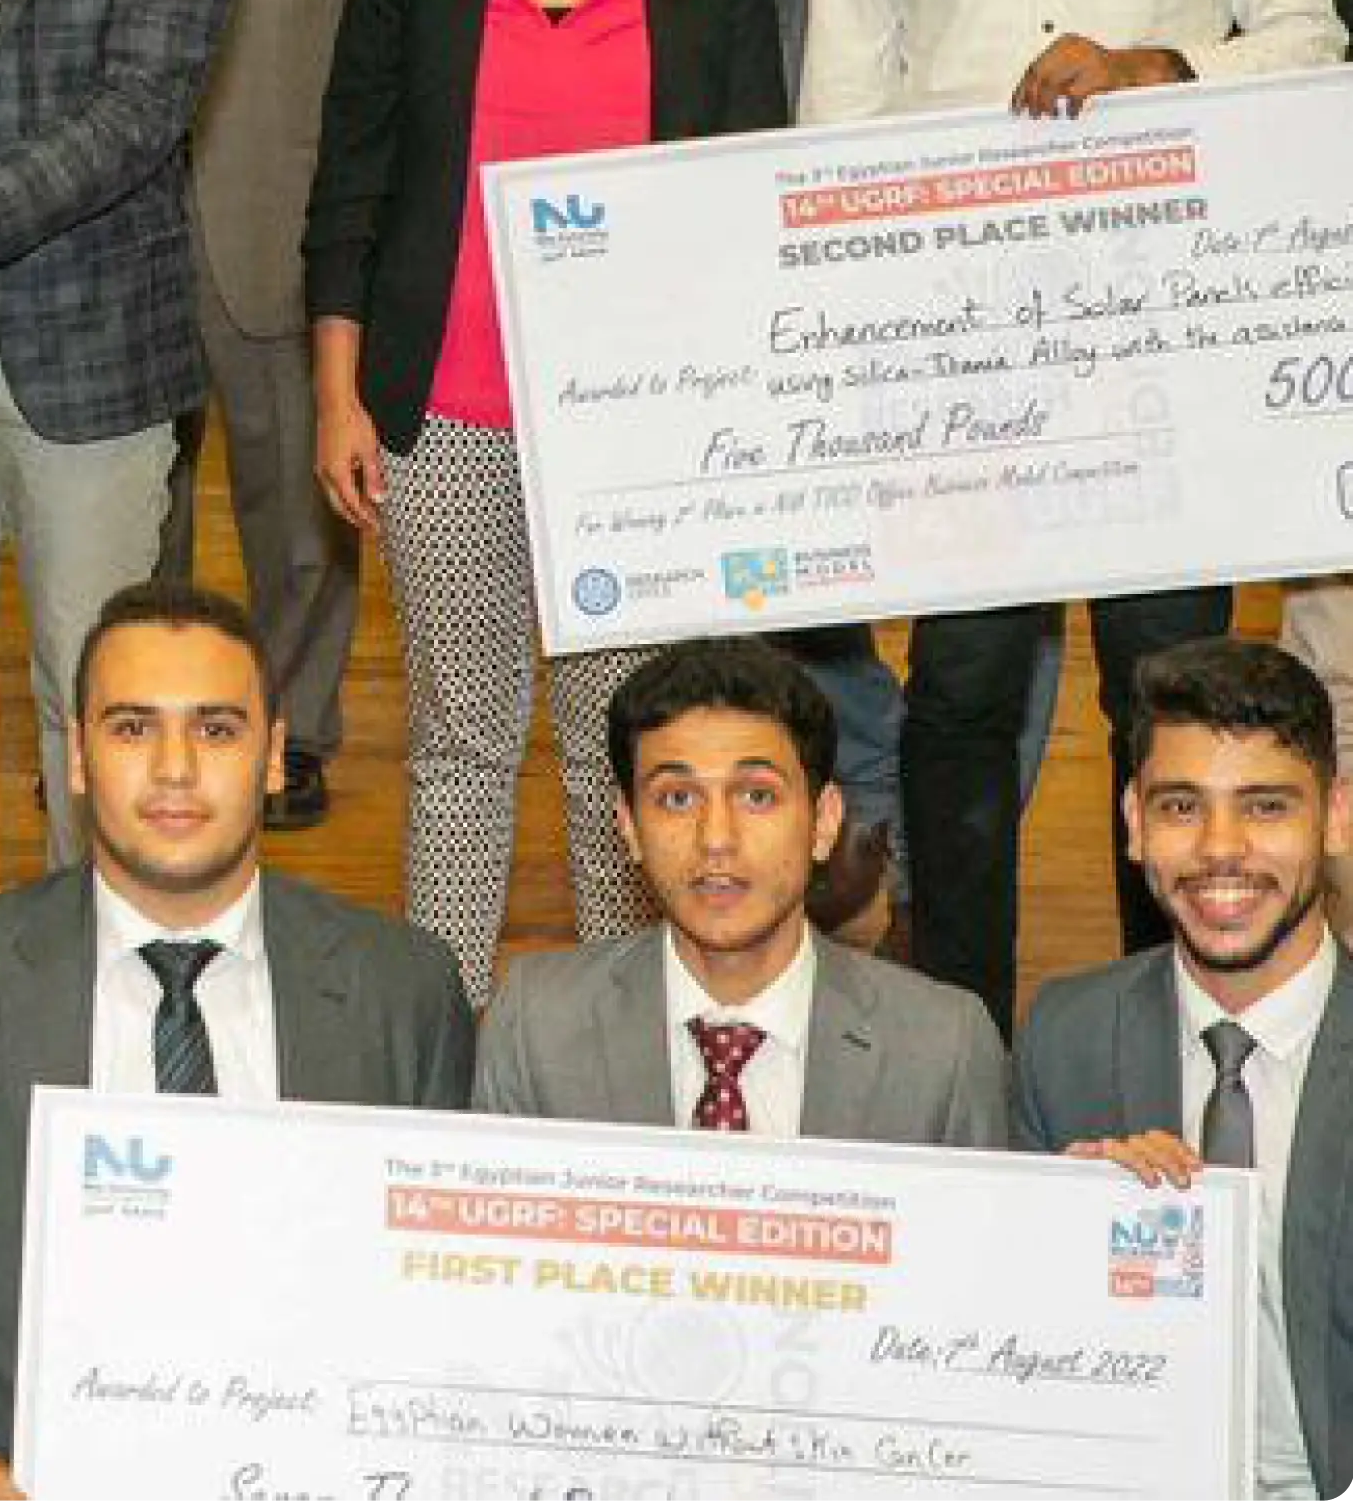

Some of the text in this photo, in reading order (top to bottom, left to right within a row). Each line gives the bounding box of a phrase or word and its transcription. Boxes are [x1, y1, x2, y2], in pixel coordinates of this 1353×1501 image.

[978, 140, 1079, 164] Researcher
[1082, 127, 1194, 153] Competition
[936, 169, 1057, 203] SPECIAL
[1068, 152, 1194, 186] EDITION
[530, 194, 606, 233] NU
[778, 198, 1209, 269] SECOND PLACE WINNER
[770, 299, 977, 355] Enhancement
[1014, 289, 1044, 329] of
[1066, 283, 1144, 321] Solar
[1032, 337, 1095, 379] Alloy
[1185, 324, 1216, 348] the
[700, 398, 1049, 475] Five Thousand Pounds
[84, 1134, 173, 1183] NU
[386, 1158, 423, 1180] The
[458, 1163, 556, 1190] Egyptian
[560, 1167, 629, 1191] Junior
[633, 1175, 752, 1203] Researcher
[760, 1184, 897, 1212] Competition
[575, 1204, 727, 1244] SPECIAL
[737, 1216, 889, 1254] EDITION
[402, 1251, 869, 1313] FIRST PLACE WINNER
[72, 1365, 182, 1403] Awarded
[986, 1334, 1084, 1385] August
